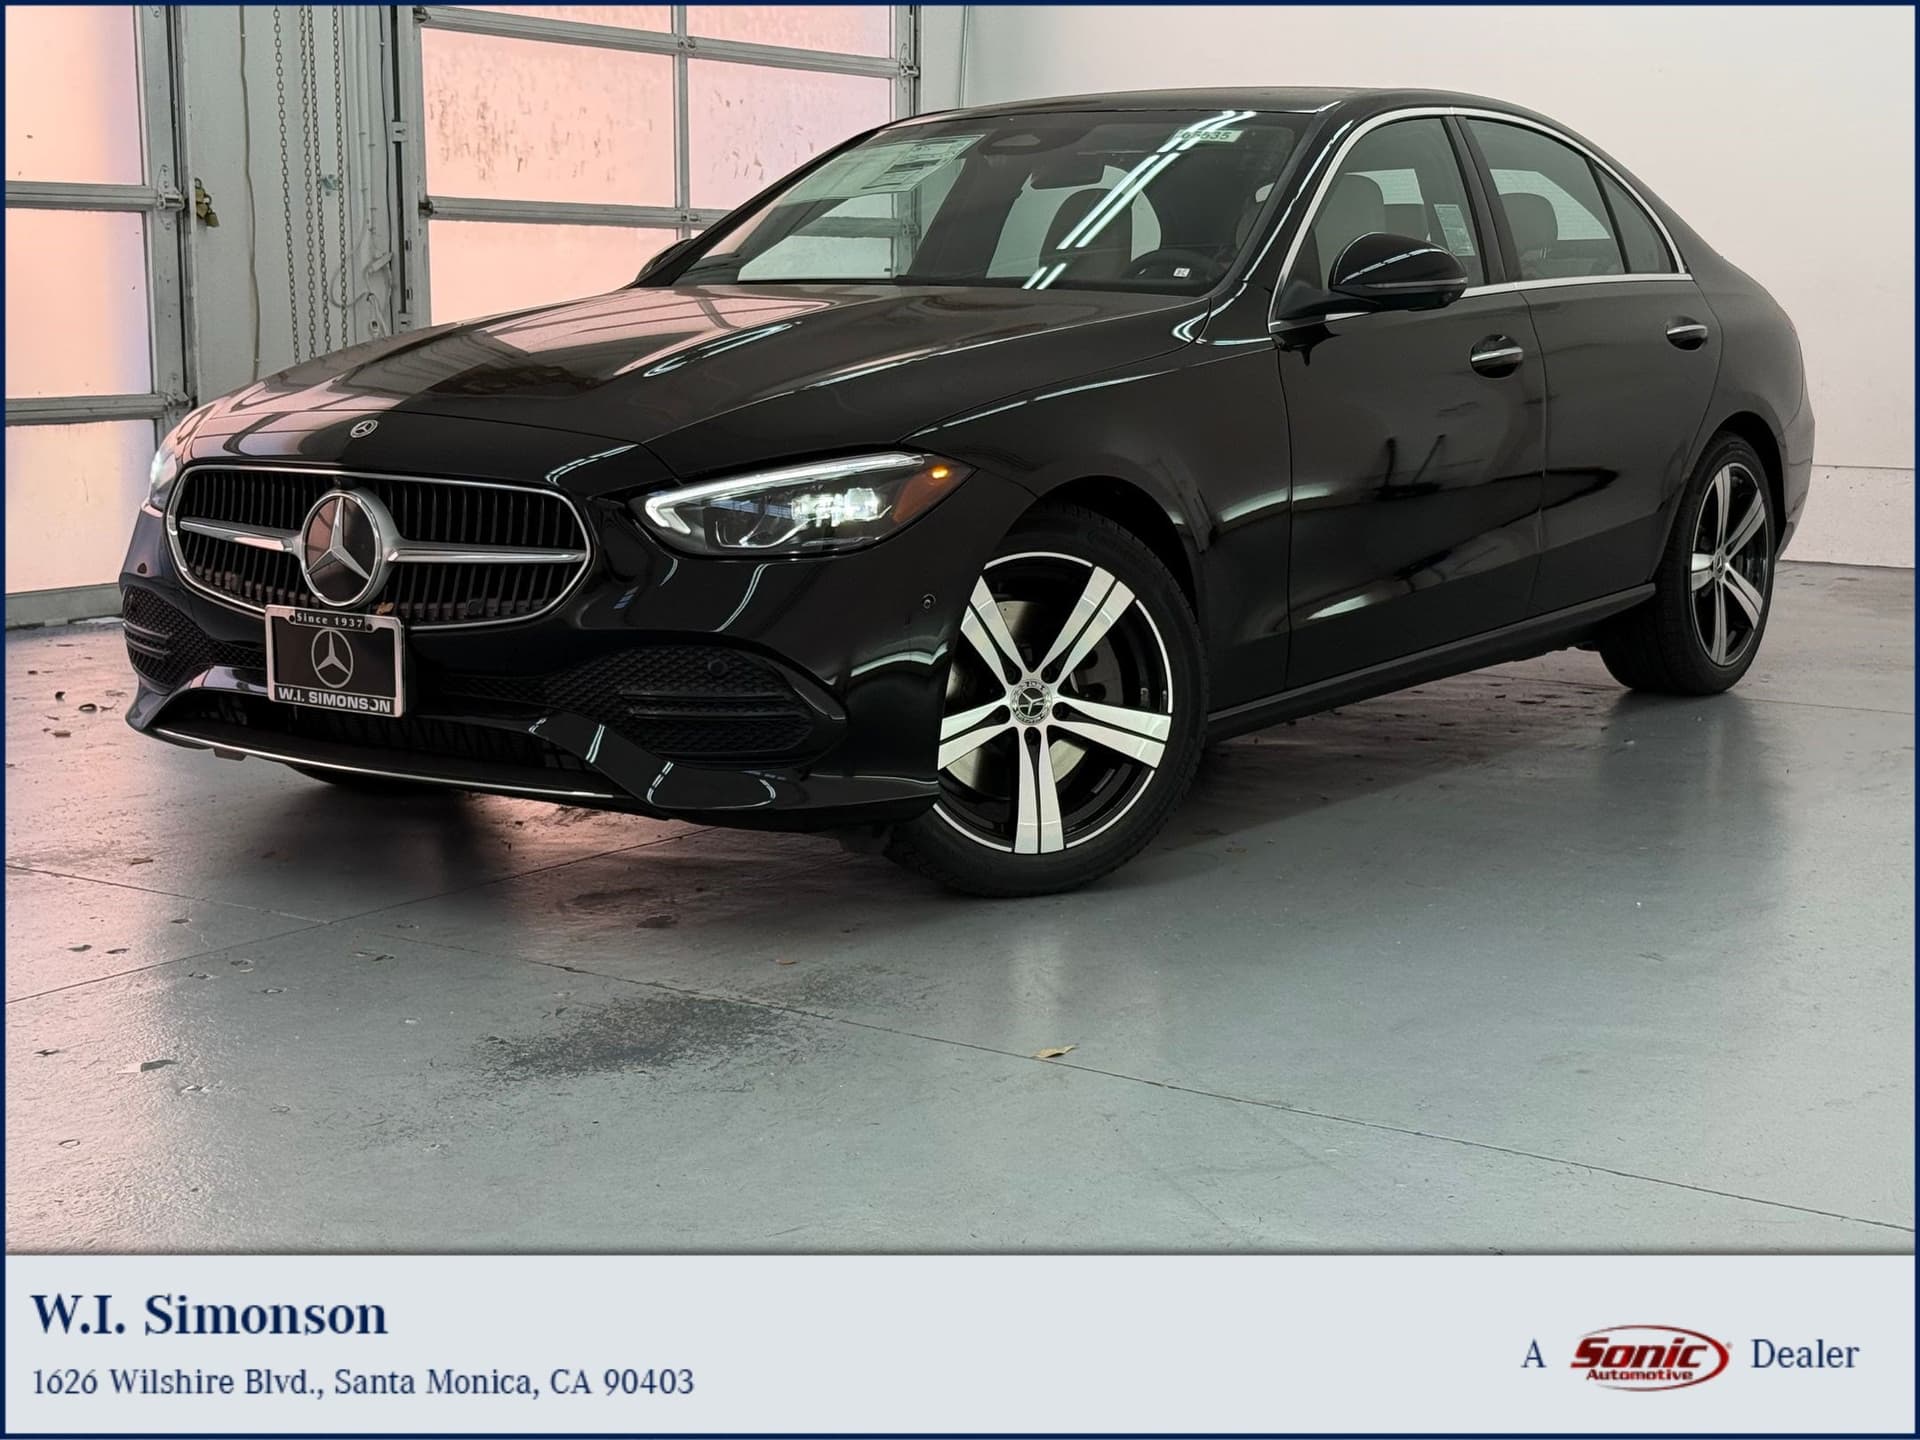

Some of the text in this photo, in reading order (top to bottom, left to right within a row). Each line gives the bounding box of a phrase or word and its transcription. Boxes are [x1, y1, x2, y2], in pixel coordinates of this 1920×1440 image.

[296, 612, 364, 629] Since 1937
[278, 687, 391, 713] W.I. SIMONSON
